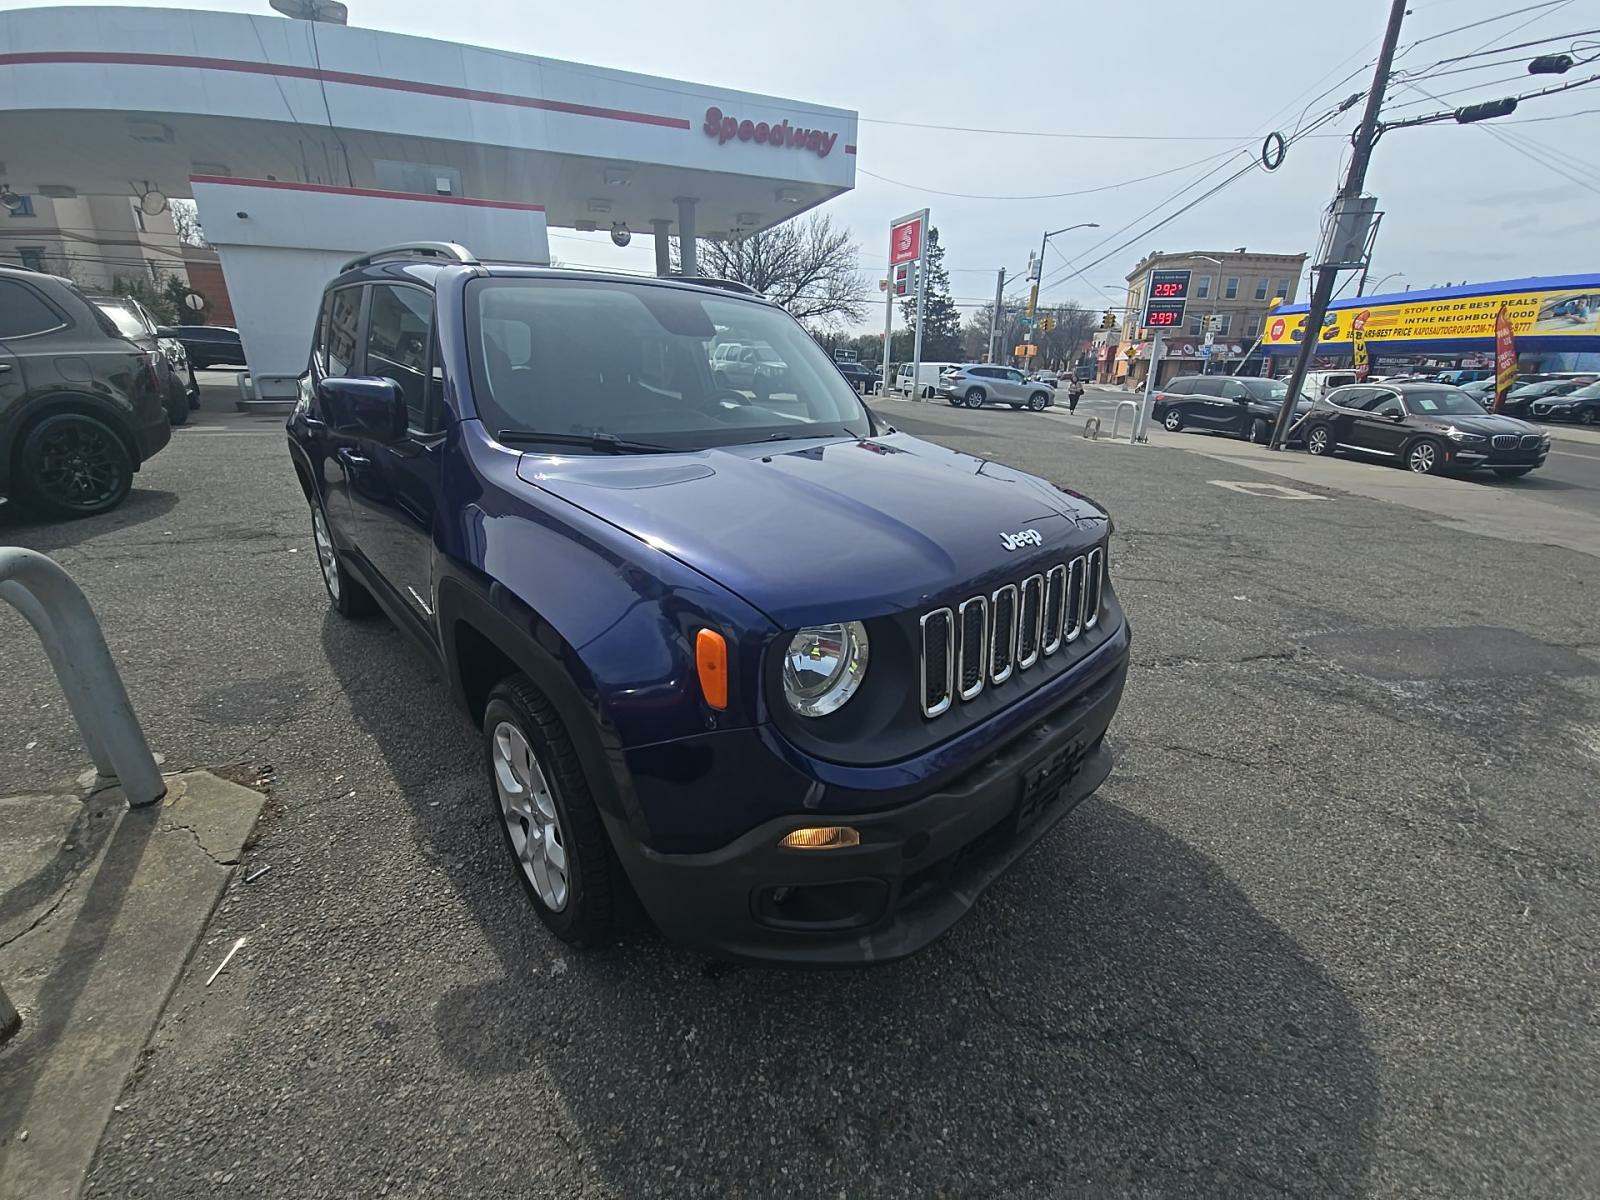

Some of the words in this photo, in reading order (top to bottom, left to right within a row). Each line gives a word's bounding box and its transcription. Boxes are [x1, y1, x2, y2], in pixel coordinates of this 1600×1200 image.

[703, 106, 838, 159] Speedway
[1404, 307, 1429, 315] STOP
[1430, 304, 1450, 312] FOR
[1452, 303, 1467, 311] DE
[1468, 301, 1497, 309] BEST
[1500, 298, 1538, 307] DEALS
[1438, 311, 1535, 323] NEIGHBOUOOD
[1392, 327, 1413, 337] PRICE
[1000, 529, 1042, 552] Jeep
